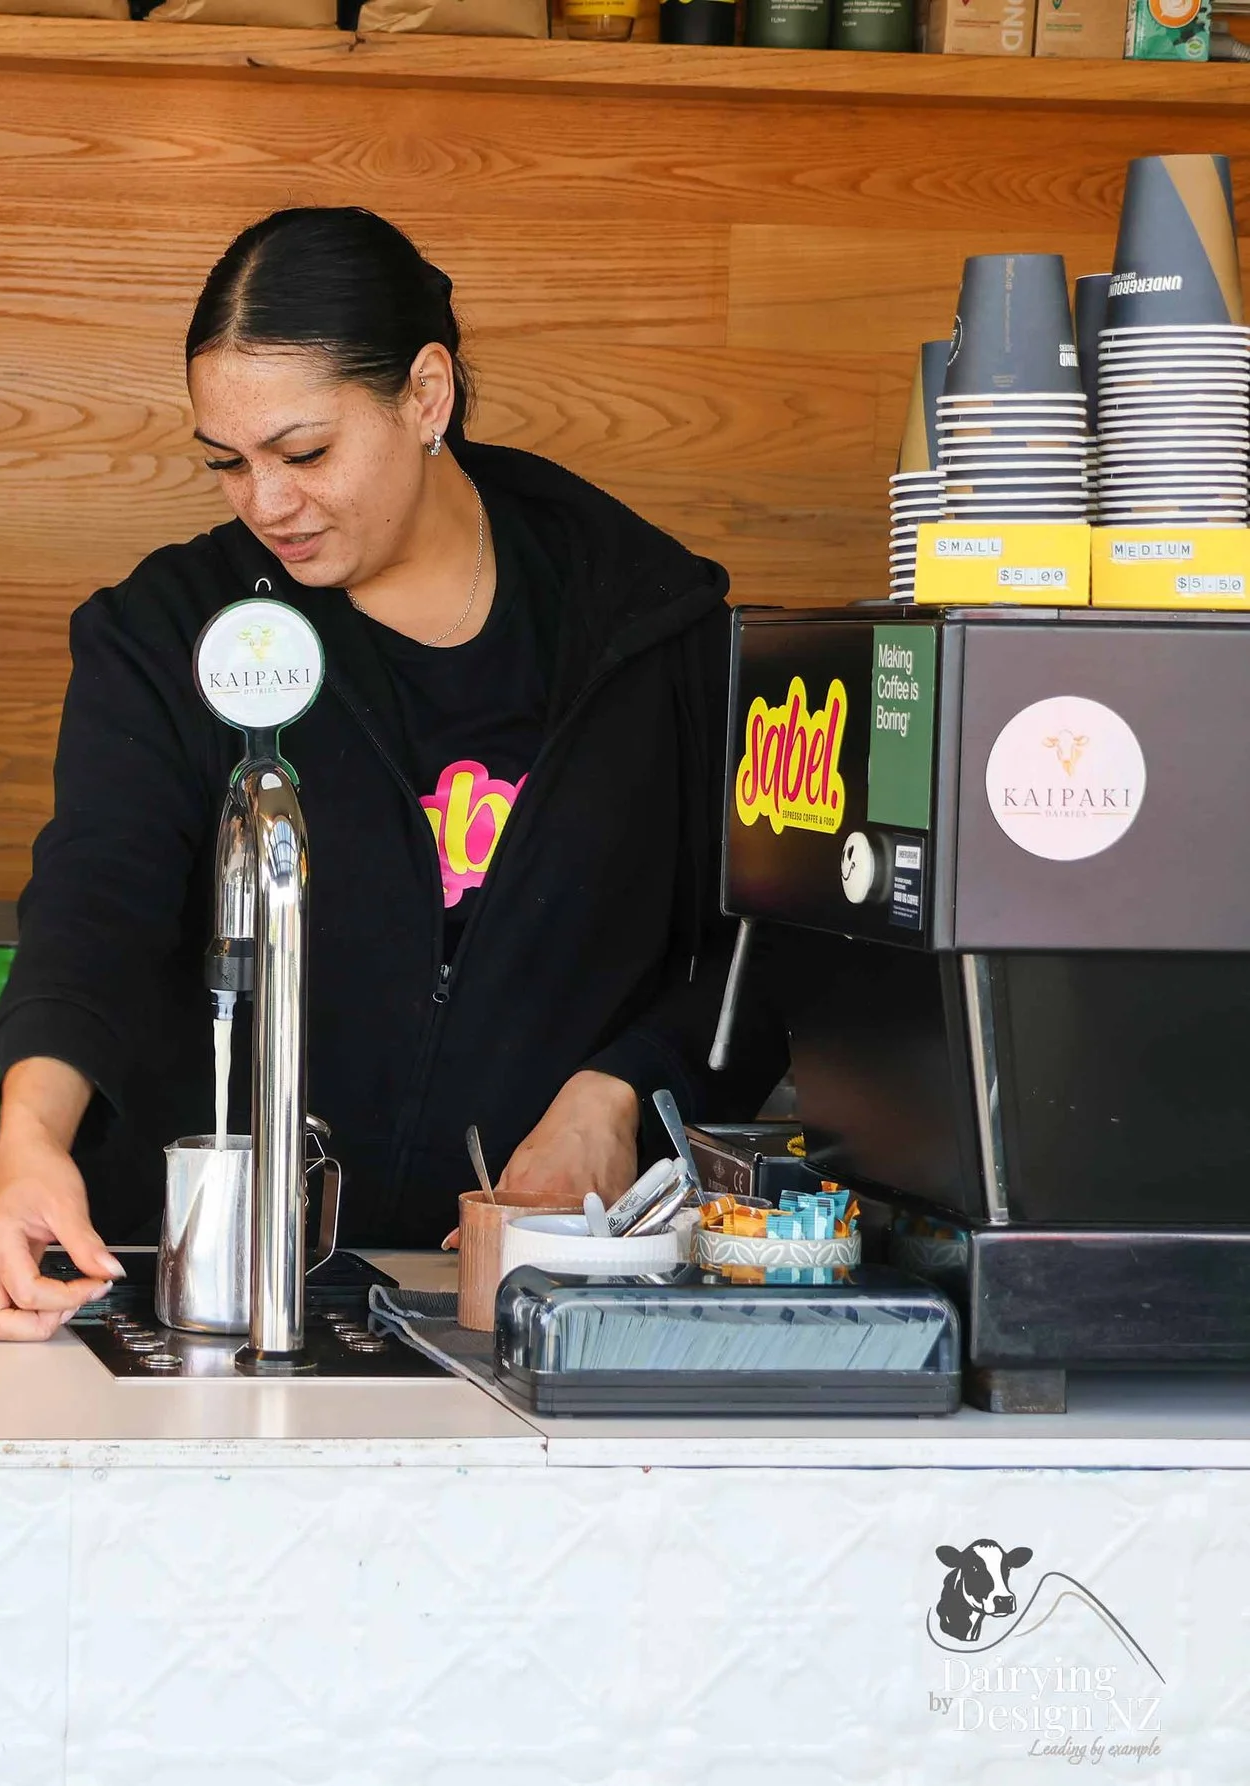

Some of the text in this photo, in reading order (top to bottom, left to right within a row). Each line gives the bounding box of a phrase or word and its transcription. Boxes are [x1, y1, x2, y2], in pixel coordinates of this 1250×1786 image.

[1001, 0, 1026, 51] ND
[937, 539, 1001, 554] SMALL
[1113, 543, 1192, 558] MEDIUM
[999, 568, 1065, 583] $5.00
[1176, 575, 1243, 592] $5.50
[878, 643, 912, 675] Making
[209, 668, 311, 688] KAIPAKI
[877, 674, 919, 701] Coffee is
[1003, 787, 1131, 808] KAIPAKI
[782, 809, 803, 821] ESPRESSO
[802, 812, 819, 824] COFFEE
